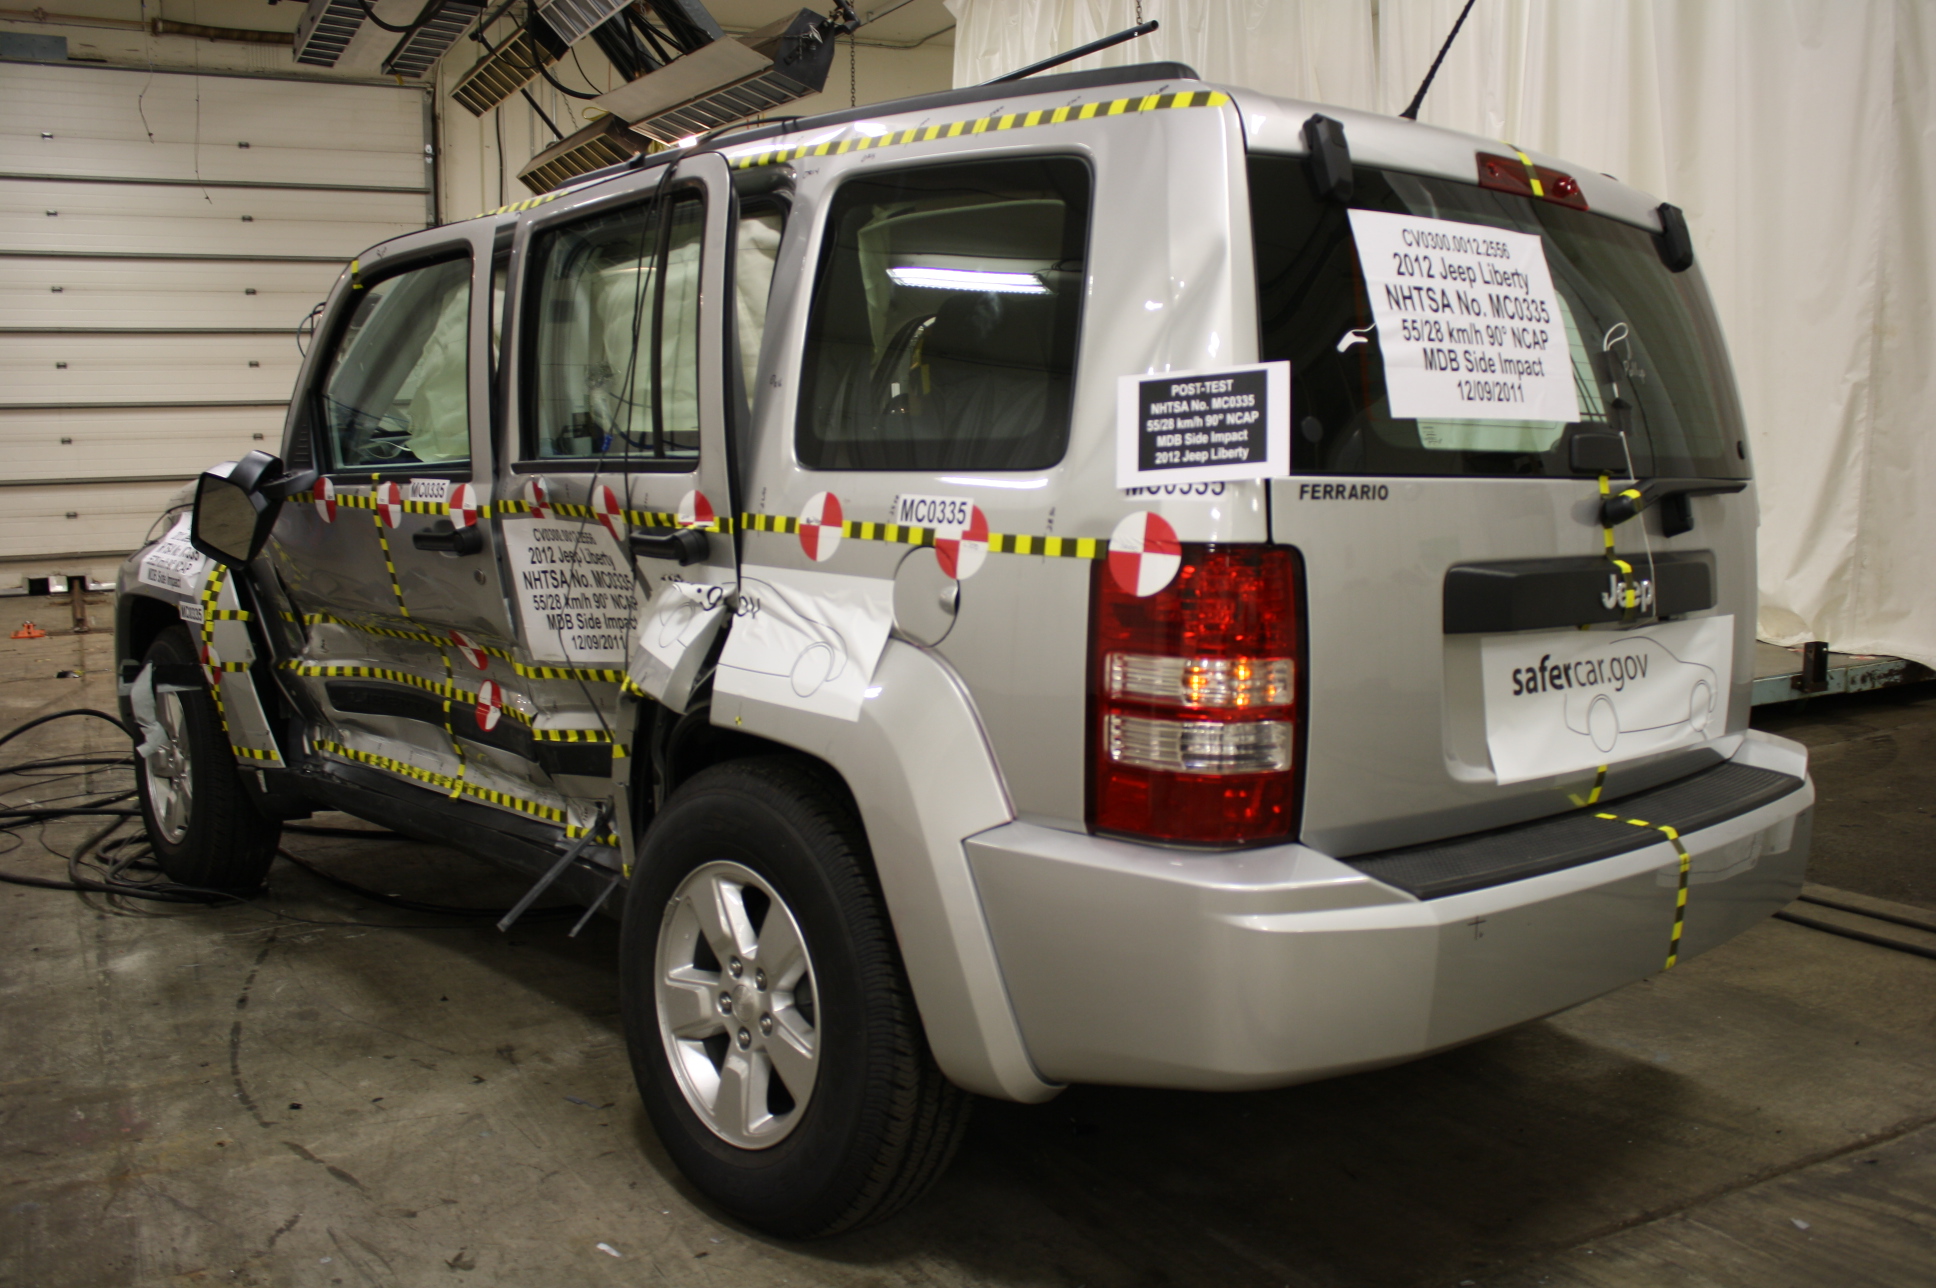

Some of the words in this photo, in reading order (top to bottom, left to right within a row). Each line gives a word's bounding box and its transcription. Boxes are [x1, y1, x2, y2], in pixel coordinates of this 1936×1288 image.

[1402, 229, 1510, 259] CV0300.0012.2556
[1393, 253, 1435, 278] 2012
[1439, 257, 1476, 288] Jeep
[1478, 262, 1529, 295] Liberty
[1384, 284, 1454, 314] NHTSA
[1456, 291, 1487, 317] No.
[1488, 293, 1550, 323] MC0335
[1401, 319, 1444, 343] 55/28
[1446, 321, 1483, 346] km/h
[1486, 325, 1507, 347] 90°
[1511, 328, 1549, 350] NCAP
[1423, 348, 1460, 372] MDB
[1464, 351, 1496, 374] Side
[1499, 353, 1544, 381] Impact
[1171, 379, 1234, 397] POST-TEST
[1457, 380, 1524, 403] 12/09/2011
[1151, 400, 1189, 416] NHTSA
[1191, 398, 1210, 412] No.
[1212, 394, 1255, 410] MC0335
[1146, 417, 1175, 432] 55/28
[1176, 414, 1203, 430] km/h
[1205, 413, 1224, 428] 90°
[1226, 411, 1259, 425] NCAP
[1157, 433, 1182, 447] MDB
[1184, 431, 1208, 446] Side
[1210, 429, 1248, 446] Impact
[1155, 451, 1181, 465] 2012
[1182, 448, 1209, 465] Jeep
[1211, 446, 1250, 462] Liberty
[1300, 483, 1389, 500] FERRARIO
[900, 498, 967, 525] MC0335
[528, 546, 556, 564] 2012
[558, 546, 582, 567] Jeep
[579, 547, 616, 571] Liberty
[522, 570, 569, 590] NHTSA
[571, 570, 593, 588] No.
[591, 570, 634, 591] MC0335
[533, 593, 562, 611] 55/28
[564, 593, 592, 609] km/h
[610, 593, 638, 611] NCAP
[1602, 574, 1653, 613] Jeep
[546, 613, 574, 630] MDB
[576, 613, 601, 630] Side
[603, 613, 638, 633] Impact
[572, 634, 626, 650] 12/09/2011
[1512, 654, 1648, 696] safercar.gov
